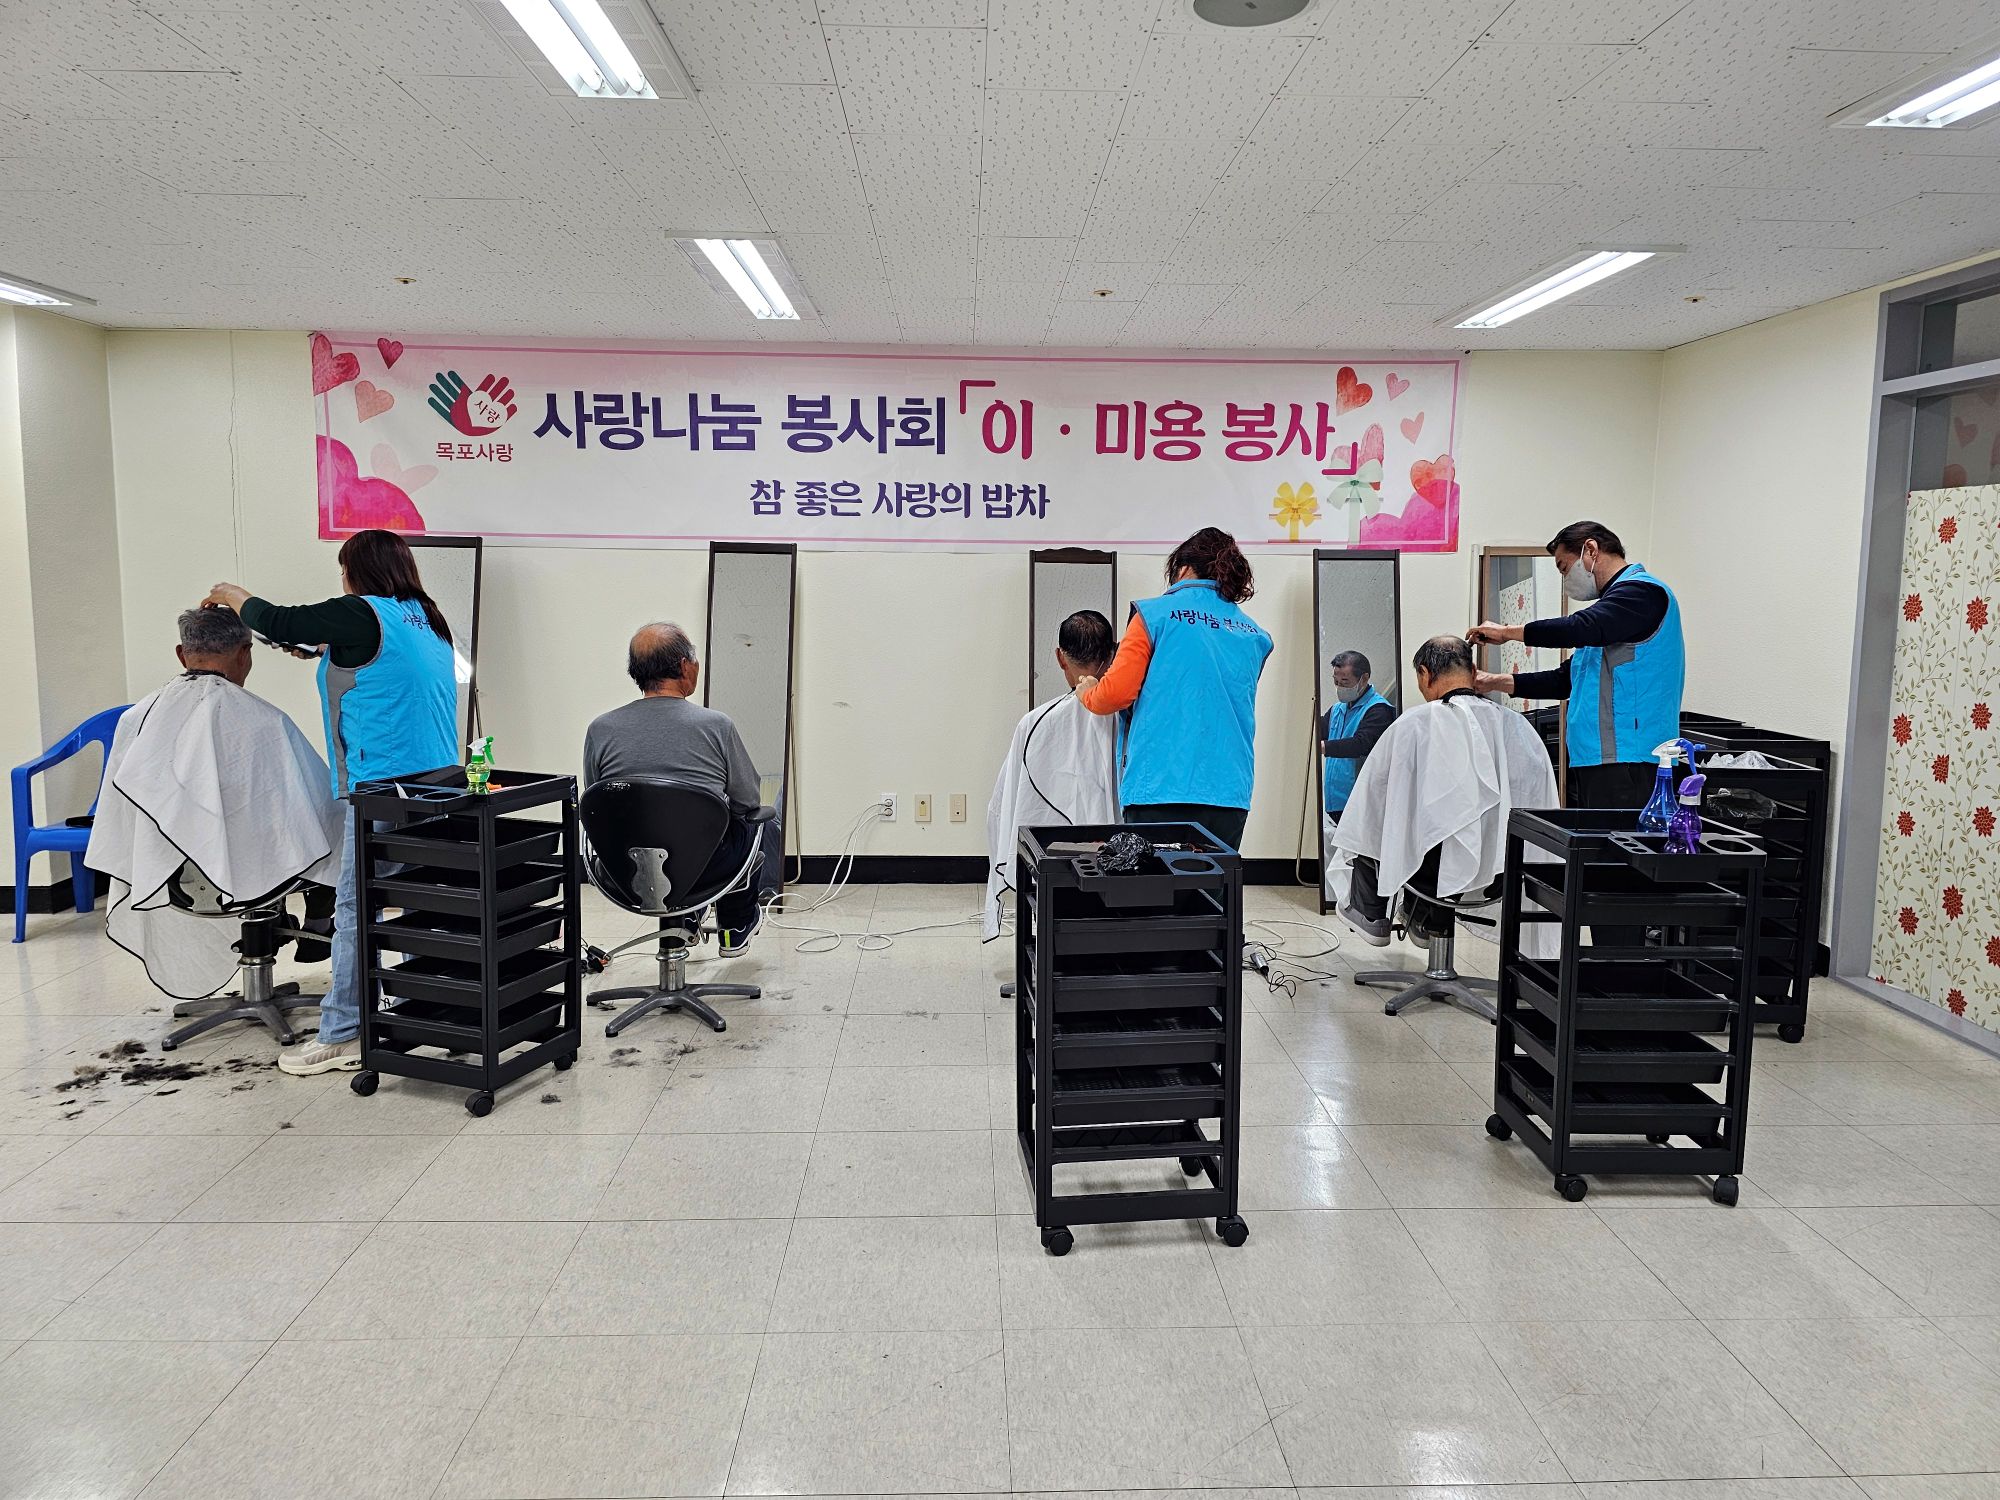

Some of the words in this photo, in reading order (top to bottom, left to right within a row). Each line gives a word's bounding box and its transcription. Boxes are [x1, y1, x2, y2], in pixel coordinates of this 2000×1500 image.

[474, 400, 501, 424] 사랑
[532, 390, 763, 452] 사랑나눔
[781, 394, 946, 456] 봉사회
[1095, 399, 1207, 462] 미용
[434, 442, 515, 463] 목포사랑
[749, 479, 786, 516] 참
[794, 479, 863, 517] 좋은
[871, 481, 972, 519] 사랑의
[981, 483, 1051, 520] 밥차
[1169, 609, 1221, 630] 사랑나눔
